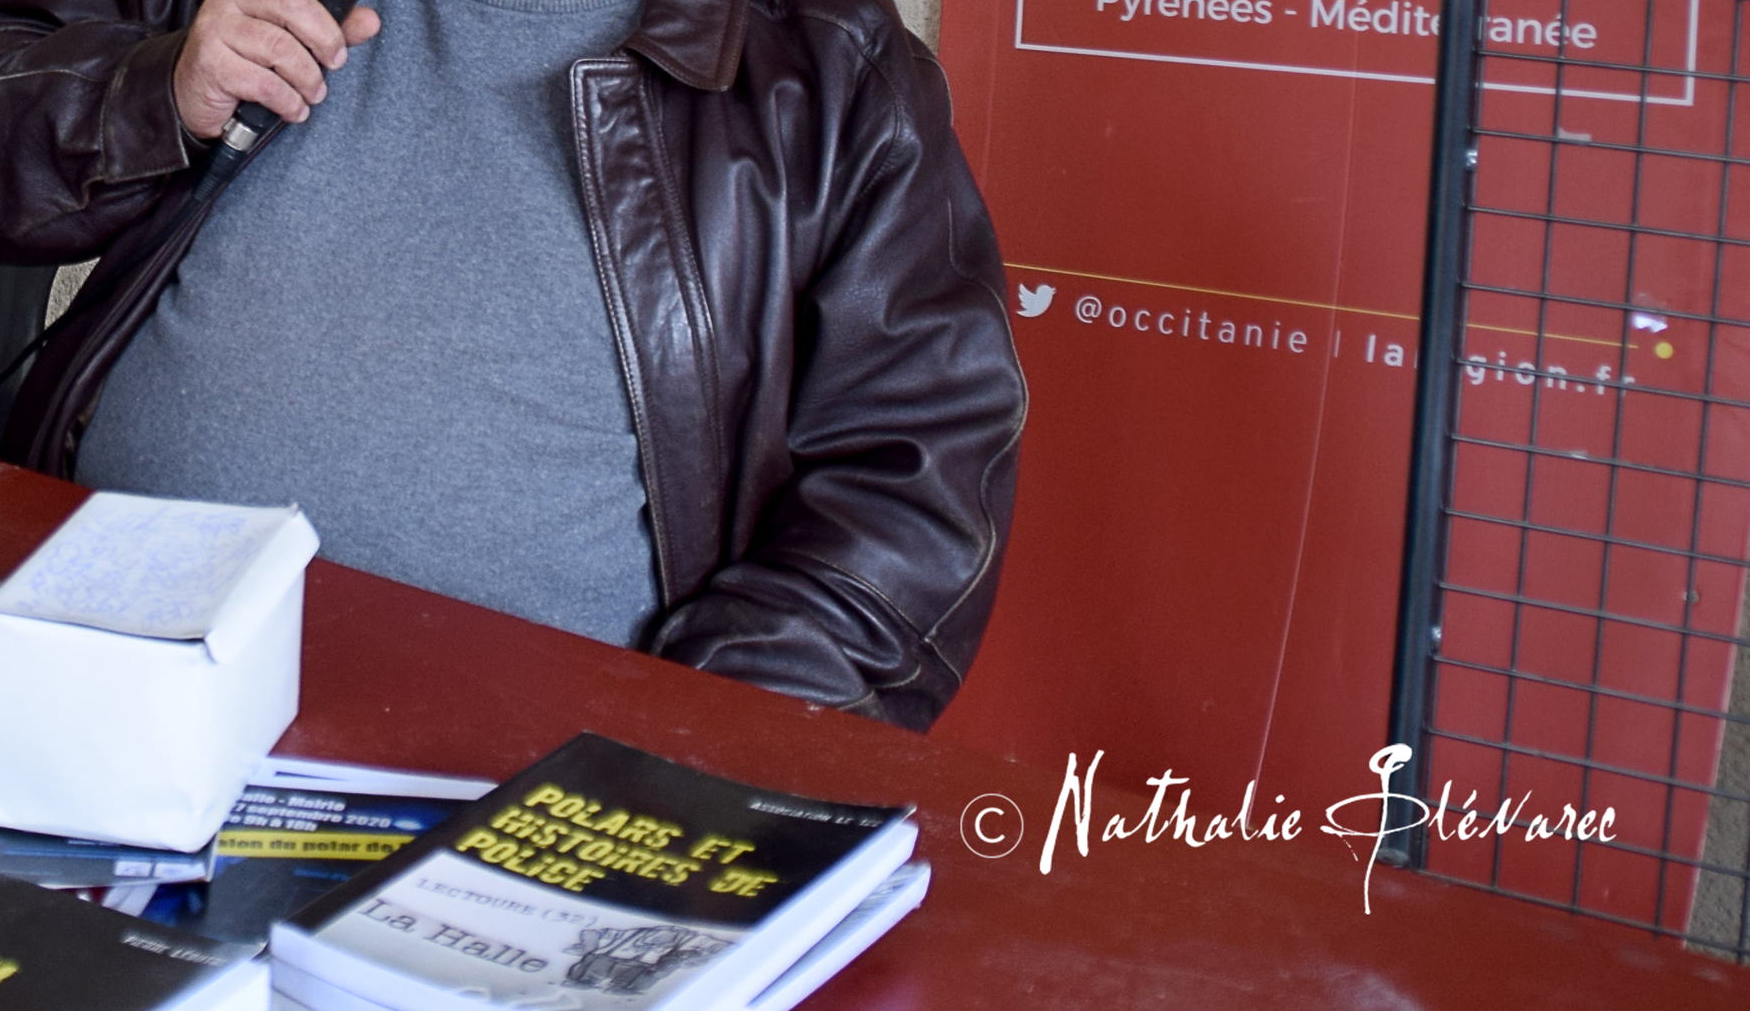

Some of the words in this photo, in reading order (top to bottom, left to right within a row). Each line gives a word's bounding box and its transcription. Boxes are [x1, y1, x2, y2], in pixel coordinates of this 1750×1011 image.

[1074, 295, 1308, 354] @occitanie
[1365, 334, 1636, 396] lagion.fr
[455, 830, 607, 893] POLICE
[489, 806, 701, 888] HISTOIRES
[708, 869, 780, 898] DE
[523, 785, 683, 852] POLARS
[696, 838, 757, 867] ET
[358, 897, 416, 932] La
[422, 923, 552, 975] Halle
